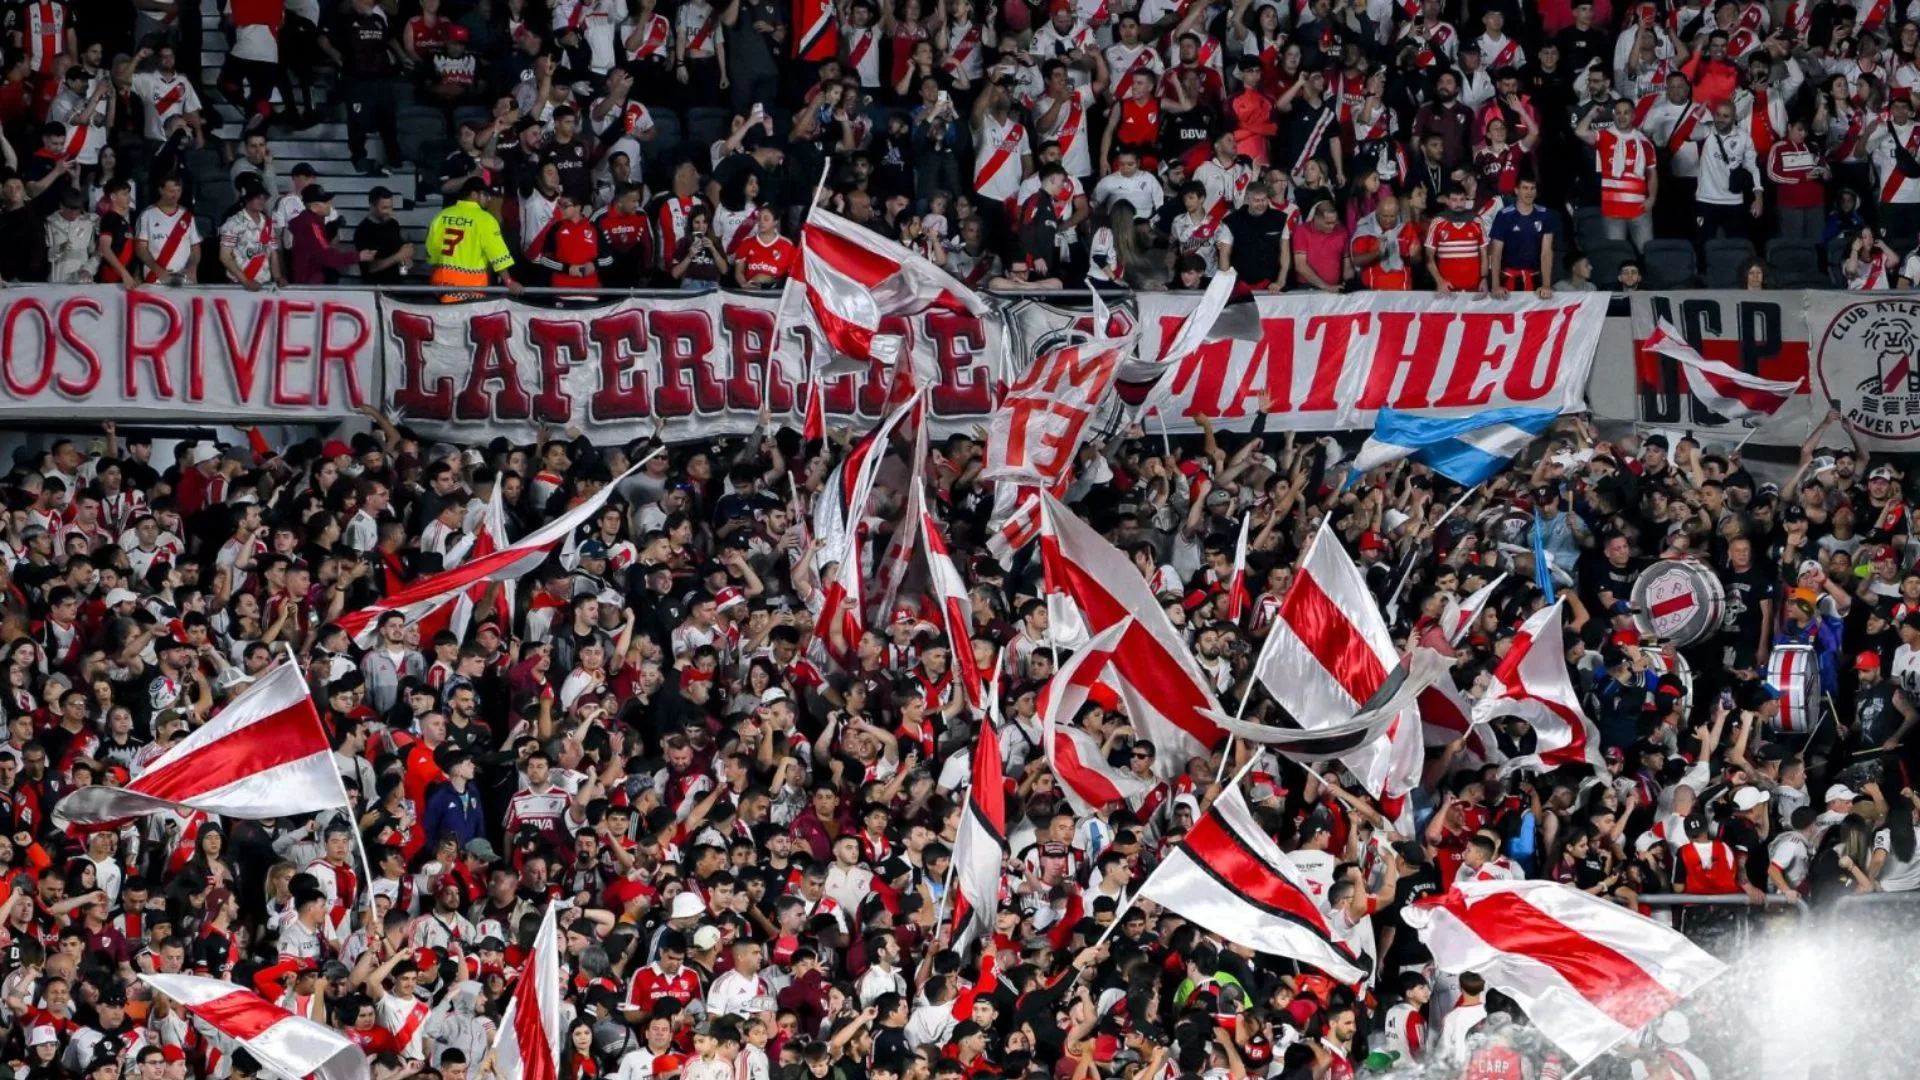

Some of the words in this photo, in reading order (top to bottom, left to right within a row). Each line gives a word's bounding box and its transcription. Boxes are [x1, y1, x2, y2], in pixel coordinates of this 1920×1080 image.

[442, 216, 473, 227] TECH
[1831, 306, 1869, 340] CLUB
[2, 297, 103, 398] OS
[123, 288, 372, 408] RIVER
[1847, 408, 1894, 434] RIVER
[1900, 668, 1917, 690] 14
